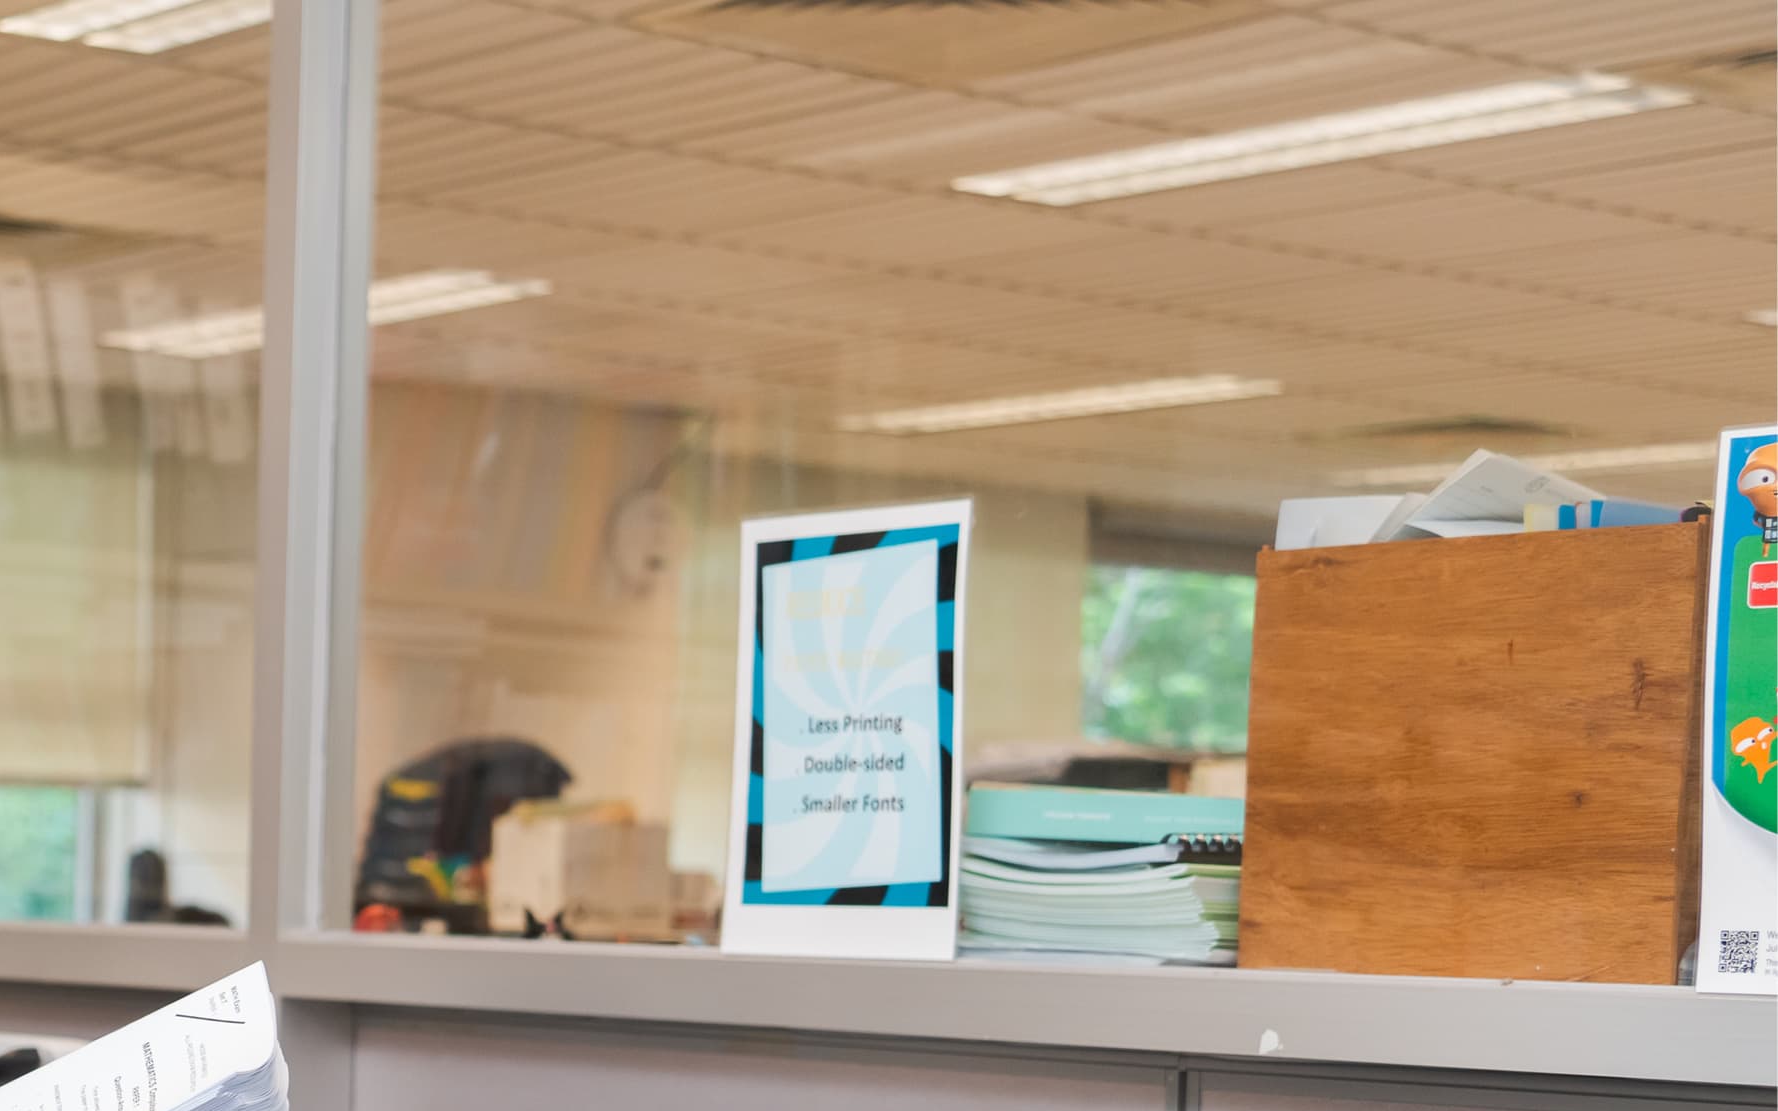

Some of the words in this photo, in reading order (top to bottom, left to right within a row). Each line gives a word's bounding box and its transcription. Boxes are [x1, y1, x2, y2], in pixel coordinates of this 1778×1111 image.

[808, 716, 839, 734] Less
[843, 713, 903, 735] Printing
[803, 752, 904, 772] Double-sided
[802, 794, 858, 813] Smaller
[863, 793, 905, 813] Fonts
[142, 1041, 157, 1088] MATHEMATICS
